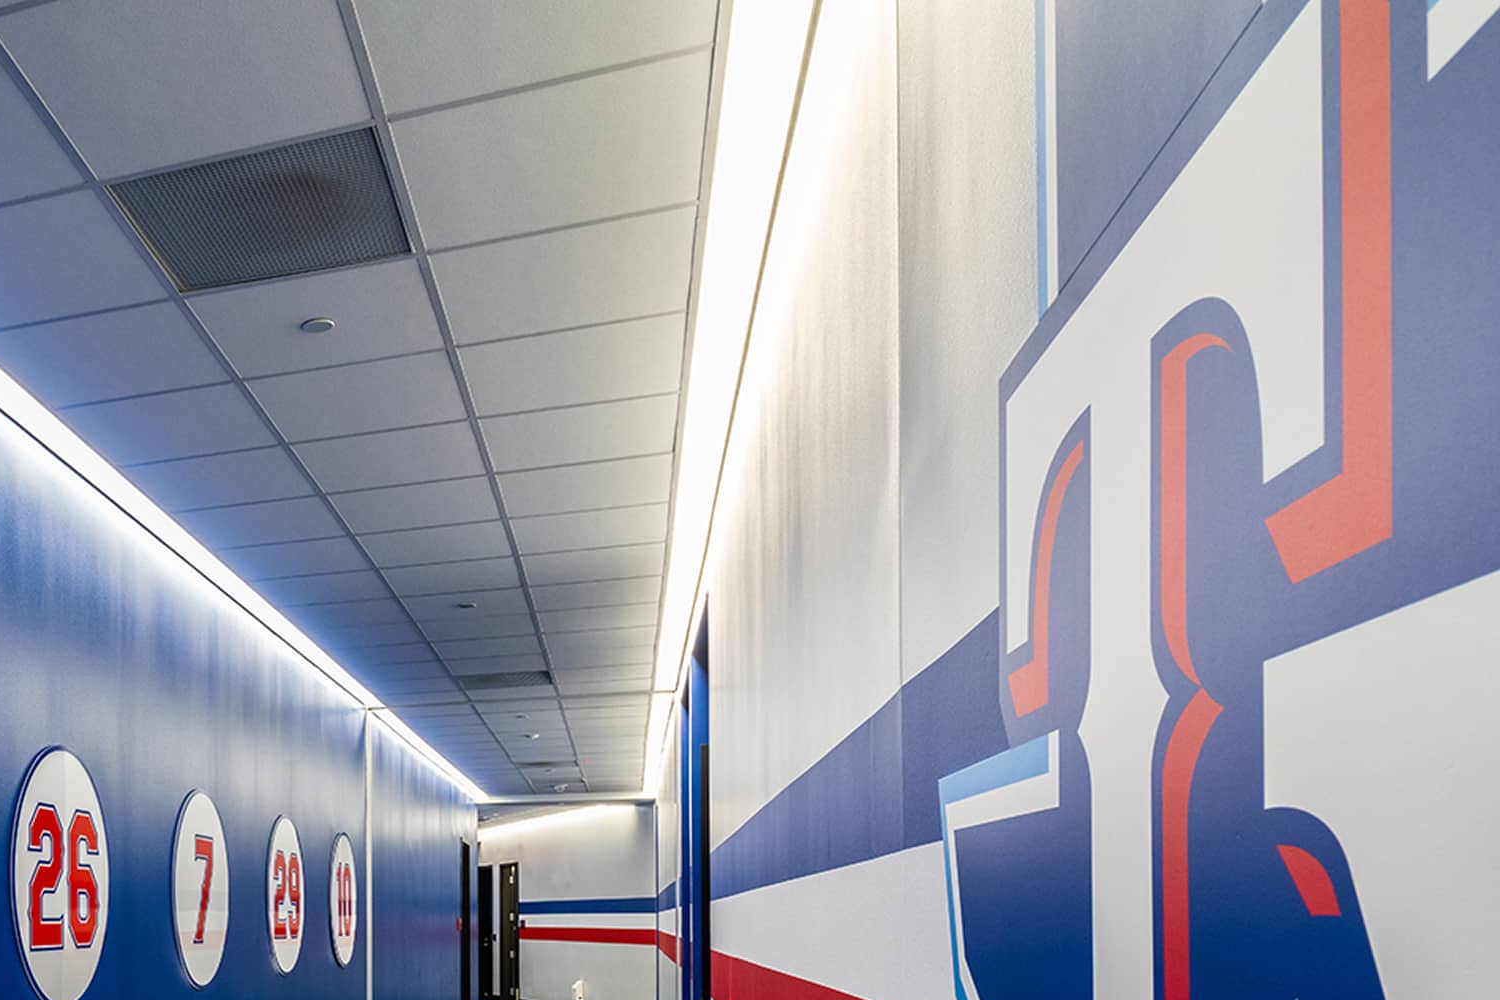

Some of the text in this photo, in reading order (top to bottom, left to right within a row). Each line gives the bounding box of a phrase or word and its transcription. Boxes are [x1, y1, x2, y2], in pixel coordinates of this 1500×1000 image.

[27, 802, 100, 952] 26
[192, 833, 214, 944] 7
[273, 850, 301, 940] 29
[336, 862, 351, 937] 10
